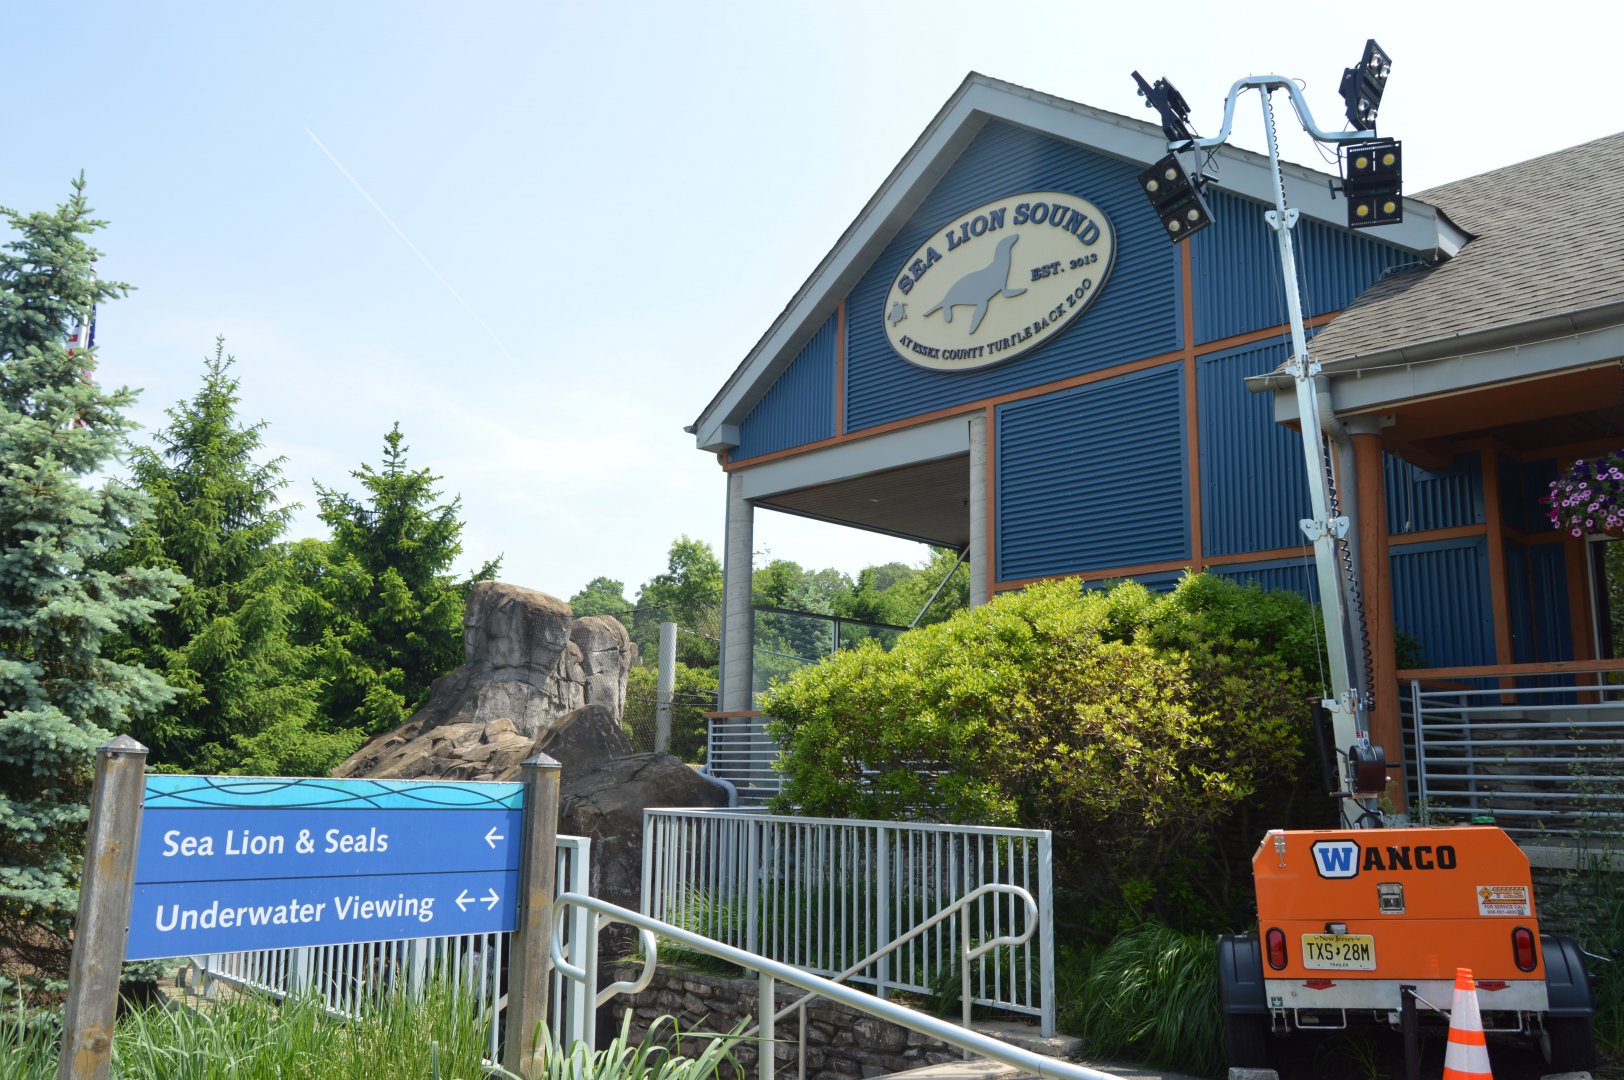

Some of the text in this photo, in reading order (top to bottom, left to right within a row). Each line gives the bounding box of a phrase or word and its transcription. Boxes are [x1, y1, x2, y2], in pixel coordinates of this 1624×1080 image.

[898, 202, 1100, 295] SEA LION SOUND
[1031, 253, 1097, 281] EST. 2013
[900, 278, 1092, 360] AT ESSEX COUNTY TURTLE BACK ZOO
[162, 827, 389, 857] Sea Lion & Seals
[1317, 844, 1457, 873] WANCO
[155, 893, 435, 932] Underwater Viewing
